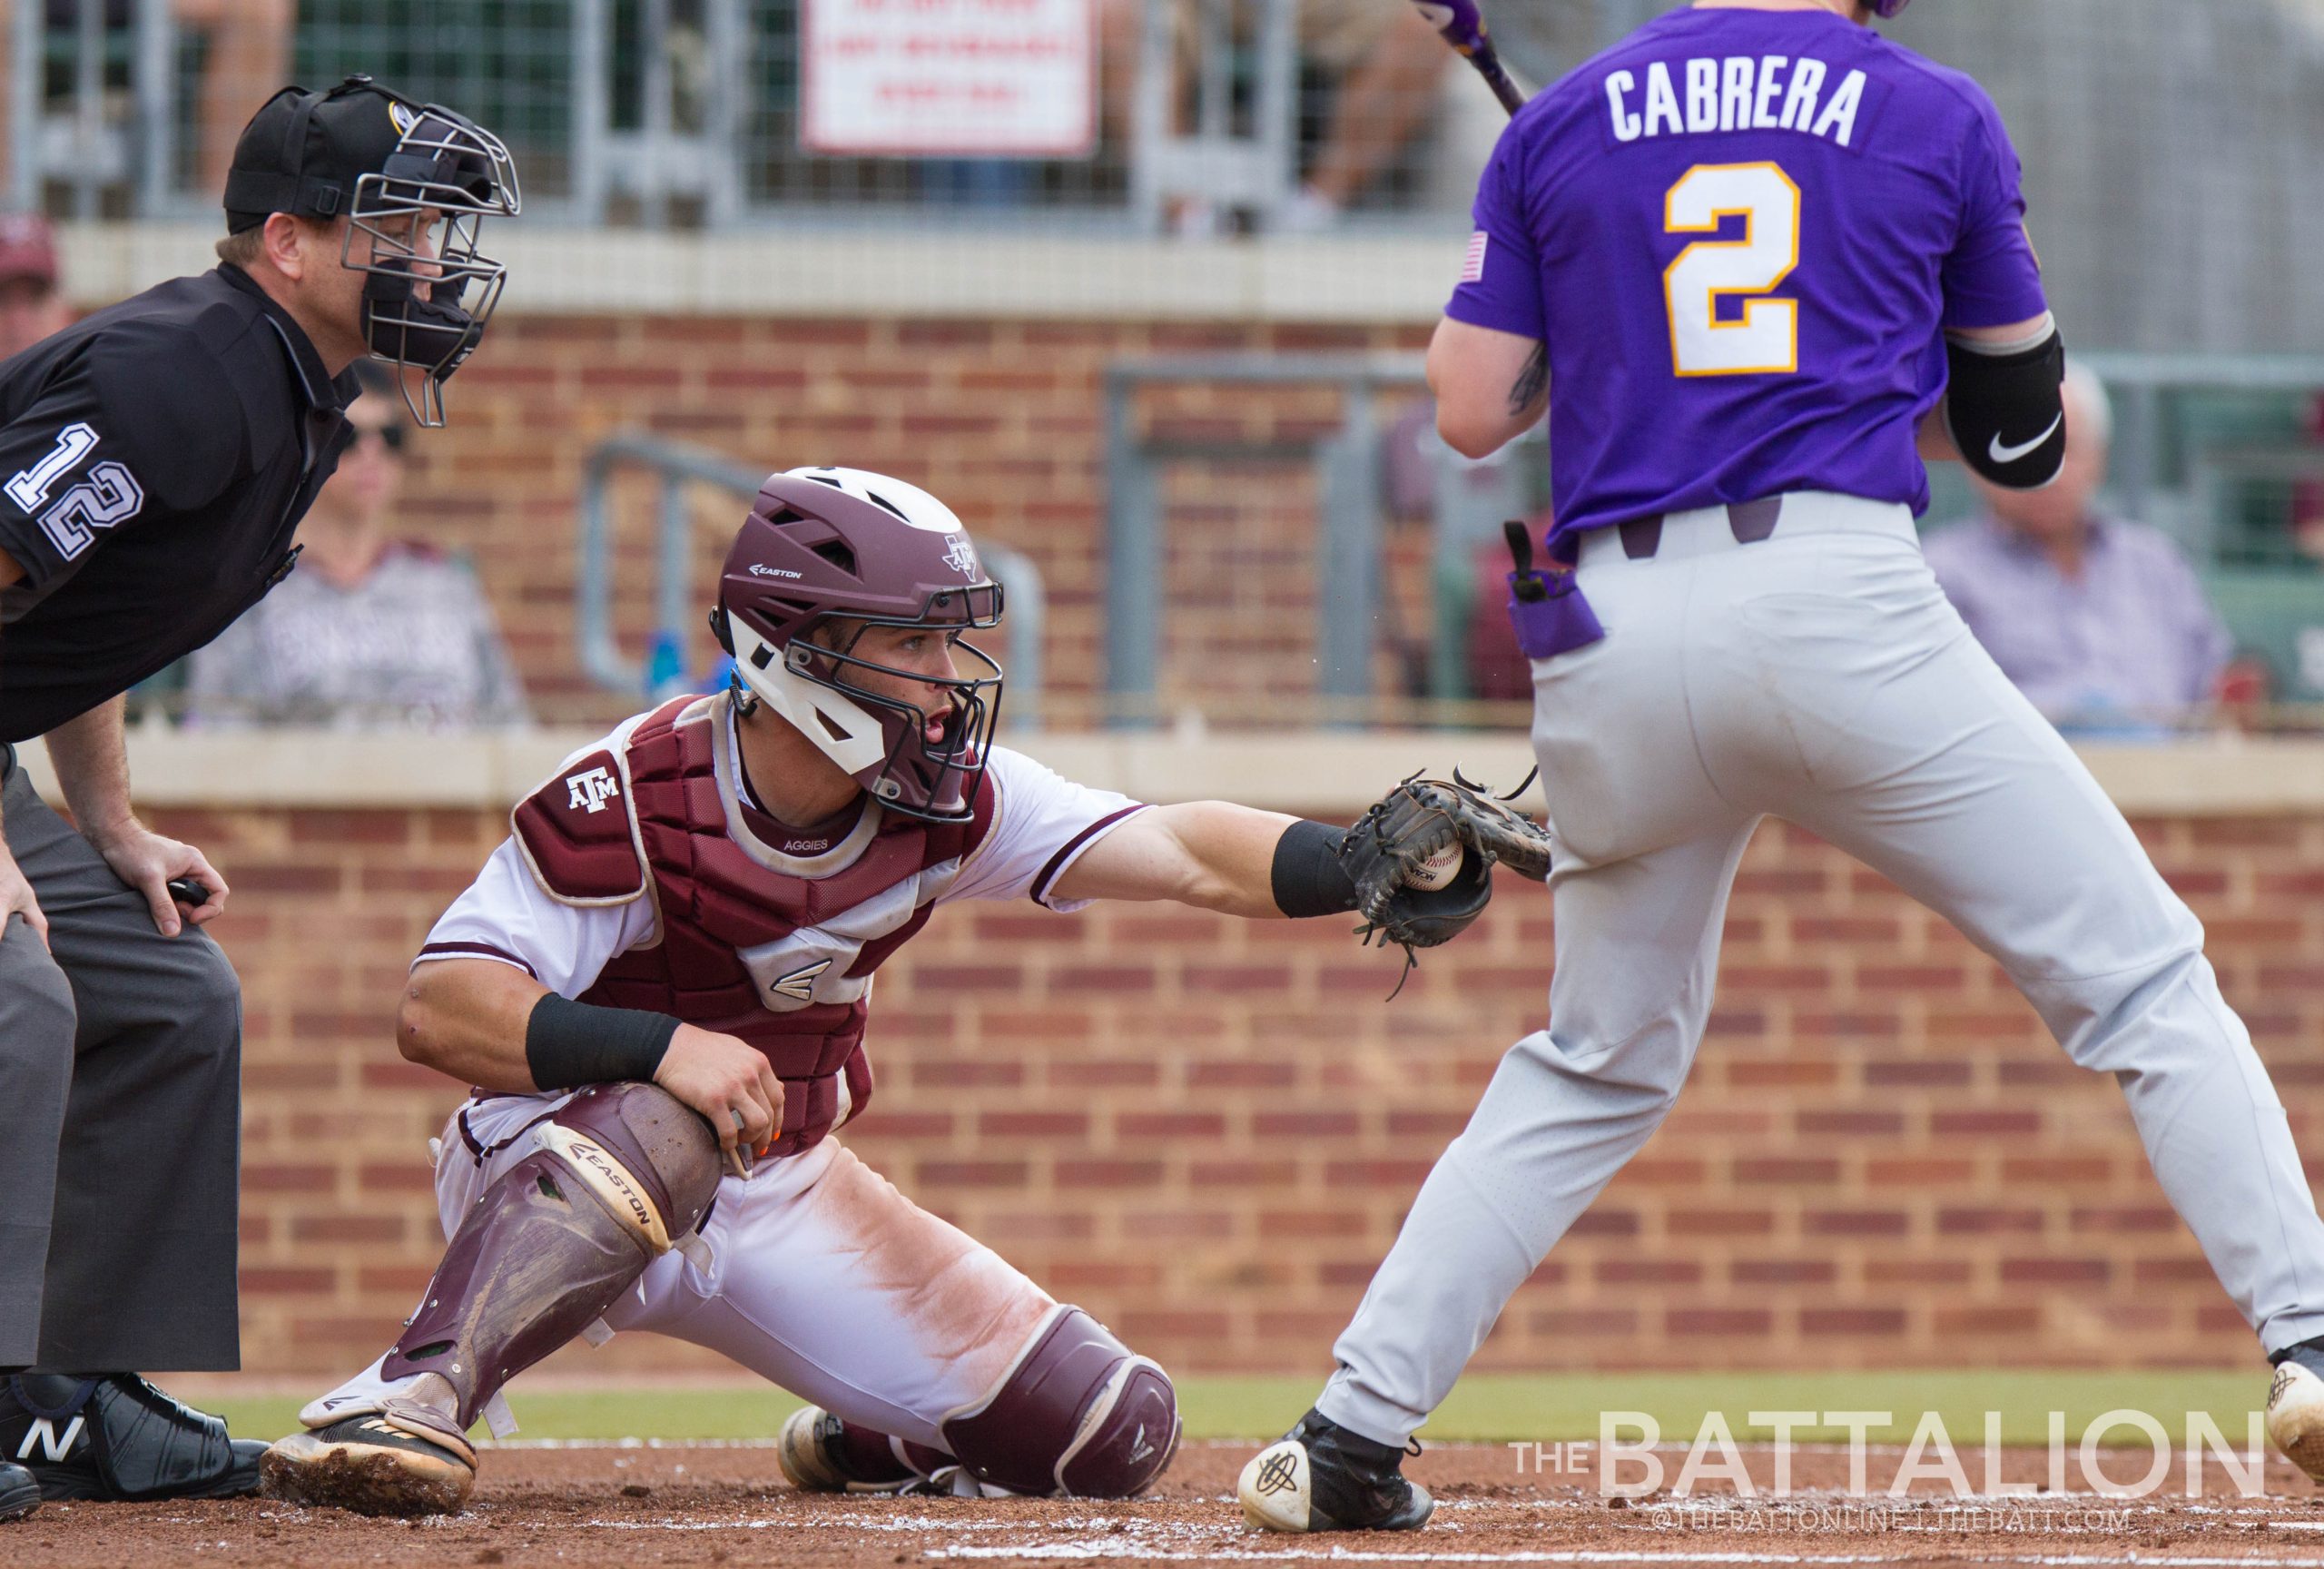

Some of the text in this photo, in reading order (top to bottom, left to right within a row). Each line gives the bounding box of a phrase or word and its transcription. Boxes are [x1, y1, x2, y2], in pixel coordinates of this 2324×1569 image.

[1605, 54, 1867, 147] CABRERA
[1663, 161, 1801, 378] 2
[3, 422, 144, 562] 12
[758, 567, 803, 579] EASTON
[783, 838, 829, 851] AGGIES
[586, 1154, 651, 1225] EASTON
